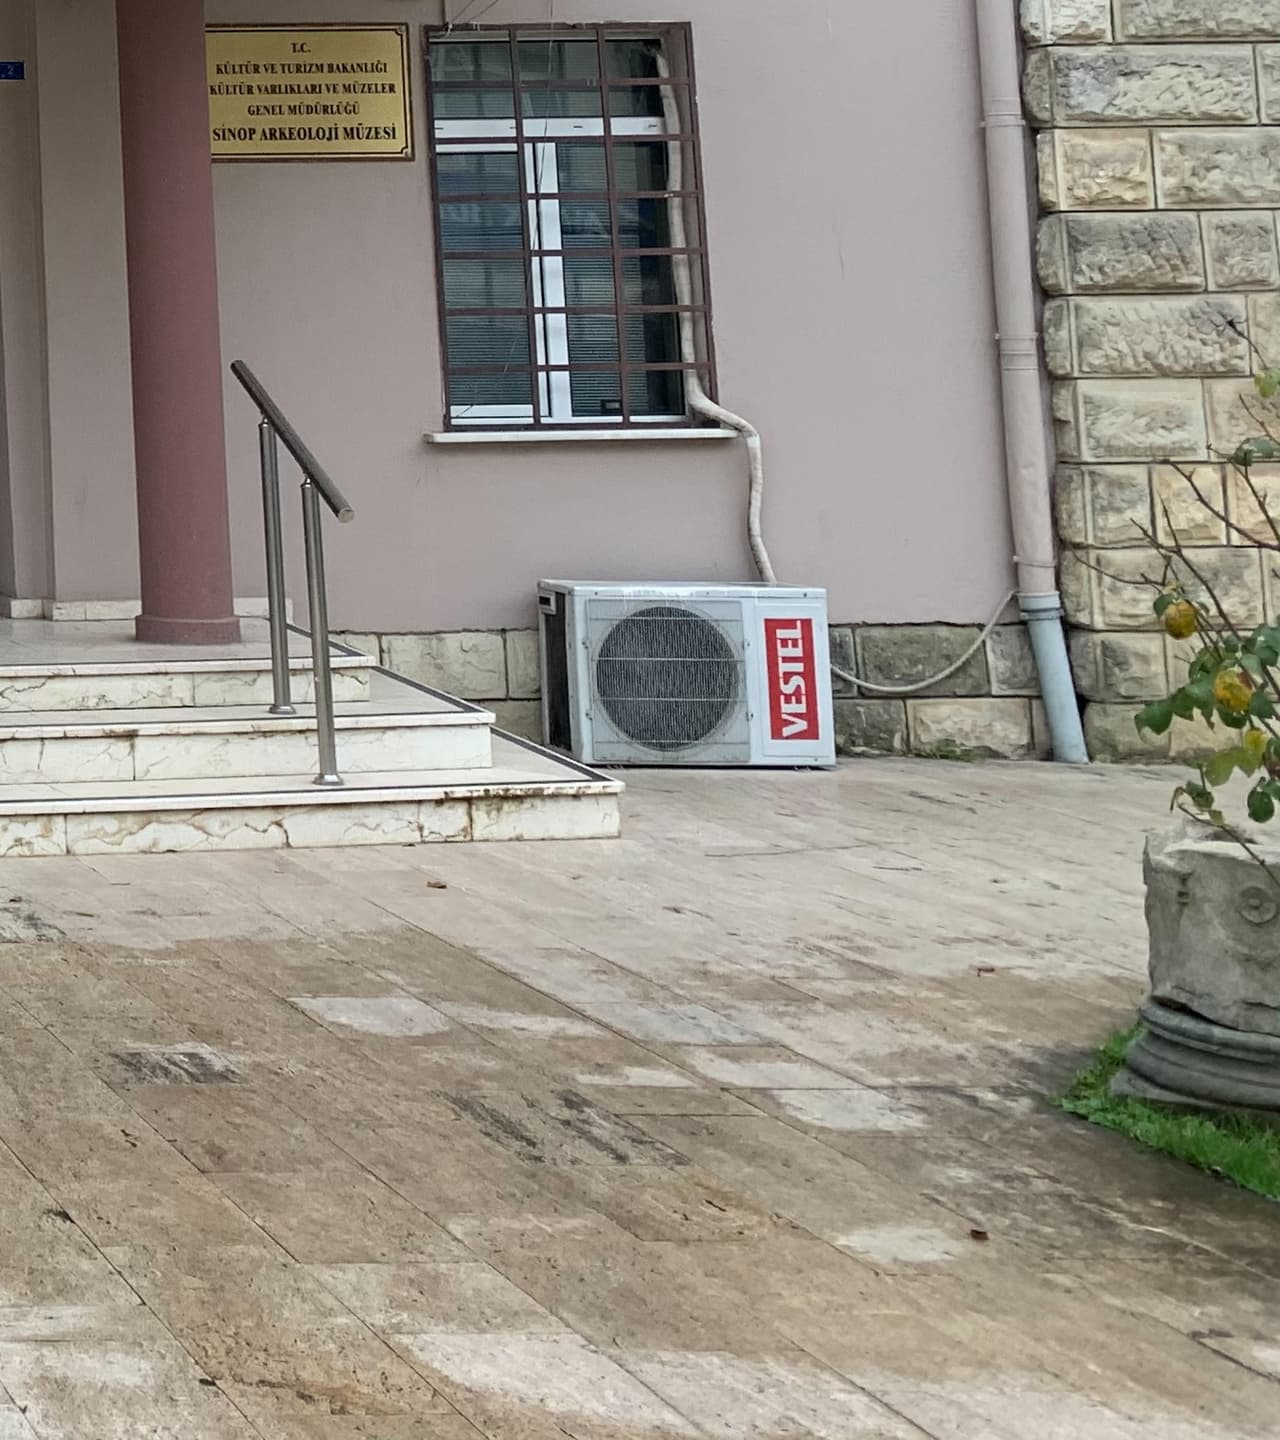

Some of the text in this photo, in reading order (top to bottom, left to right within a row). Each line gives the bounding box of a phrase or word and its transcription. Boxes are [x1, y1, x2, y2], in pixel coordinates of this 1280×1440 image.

[290, 42, 311, 53] T.C.
[216, 59, 388, 75] KÜLTÜR VE TURİZM BAKANLIĞI
[209, 80, 396, 95] KÜLTÜR VARLIKLARI VE MÜZELER
[247, 101, 360, 116] GENEL MÜDÜRLÜĞÜ
[212, 121, 397, 142] SİNOP ARKEOLOJİ MÜZESİ
[775, 620, 809, 738] VESTEL
